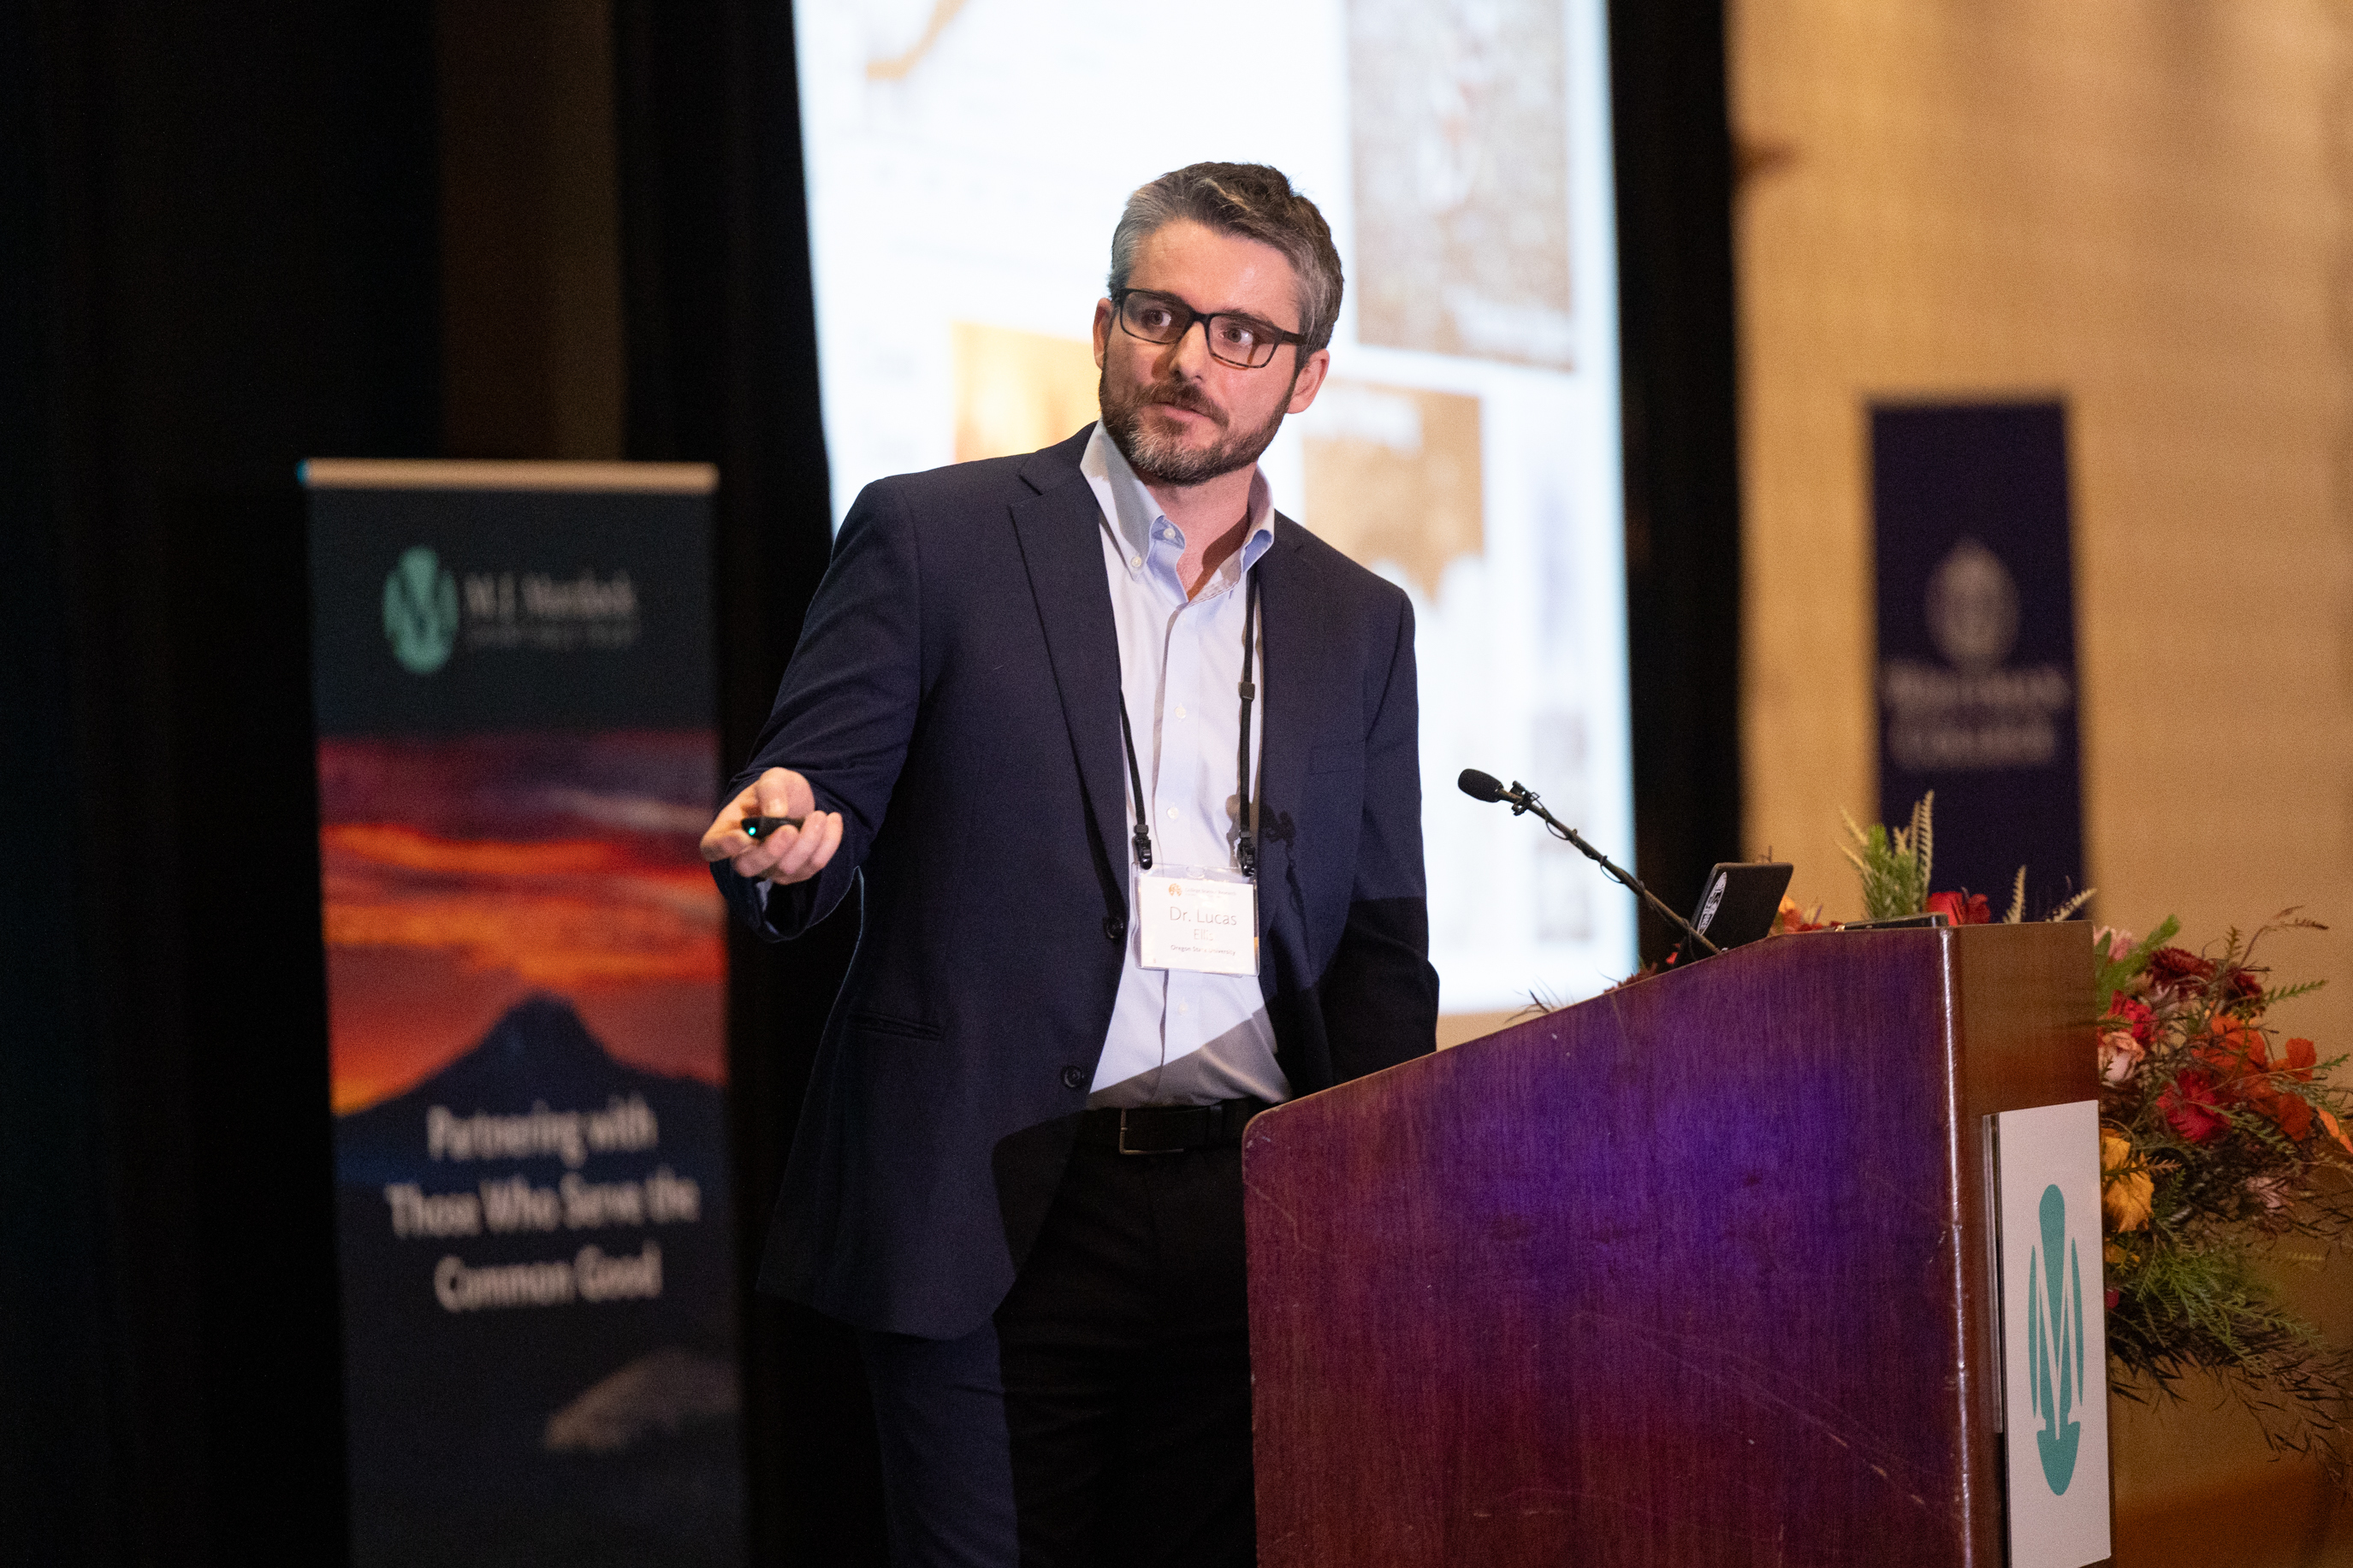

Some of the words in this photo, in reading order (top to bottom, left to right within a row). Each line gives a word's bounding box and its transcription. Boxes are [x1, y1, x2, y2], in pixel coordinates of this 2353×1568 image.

[1170, 907, 1191, 922] Dr.
[1197, 909, 1237, 926] Lucas
[1194, 929, 1214, 941] Ellis
[430, 1100, 588, 1169] Partnering
[588, 1093, 658, 1152] with
[385, 1182, 482, 1238] Those
[482, 1175, 560, 1232] Who
[560, 1173, 645, 1228] Serve
[646, 1166, 701, 1222] the
[434, 1255, 574, 1312] Common
[574, 1240, 663, 1302] Good
